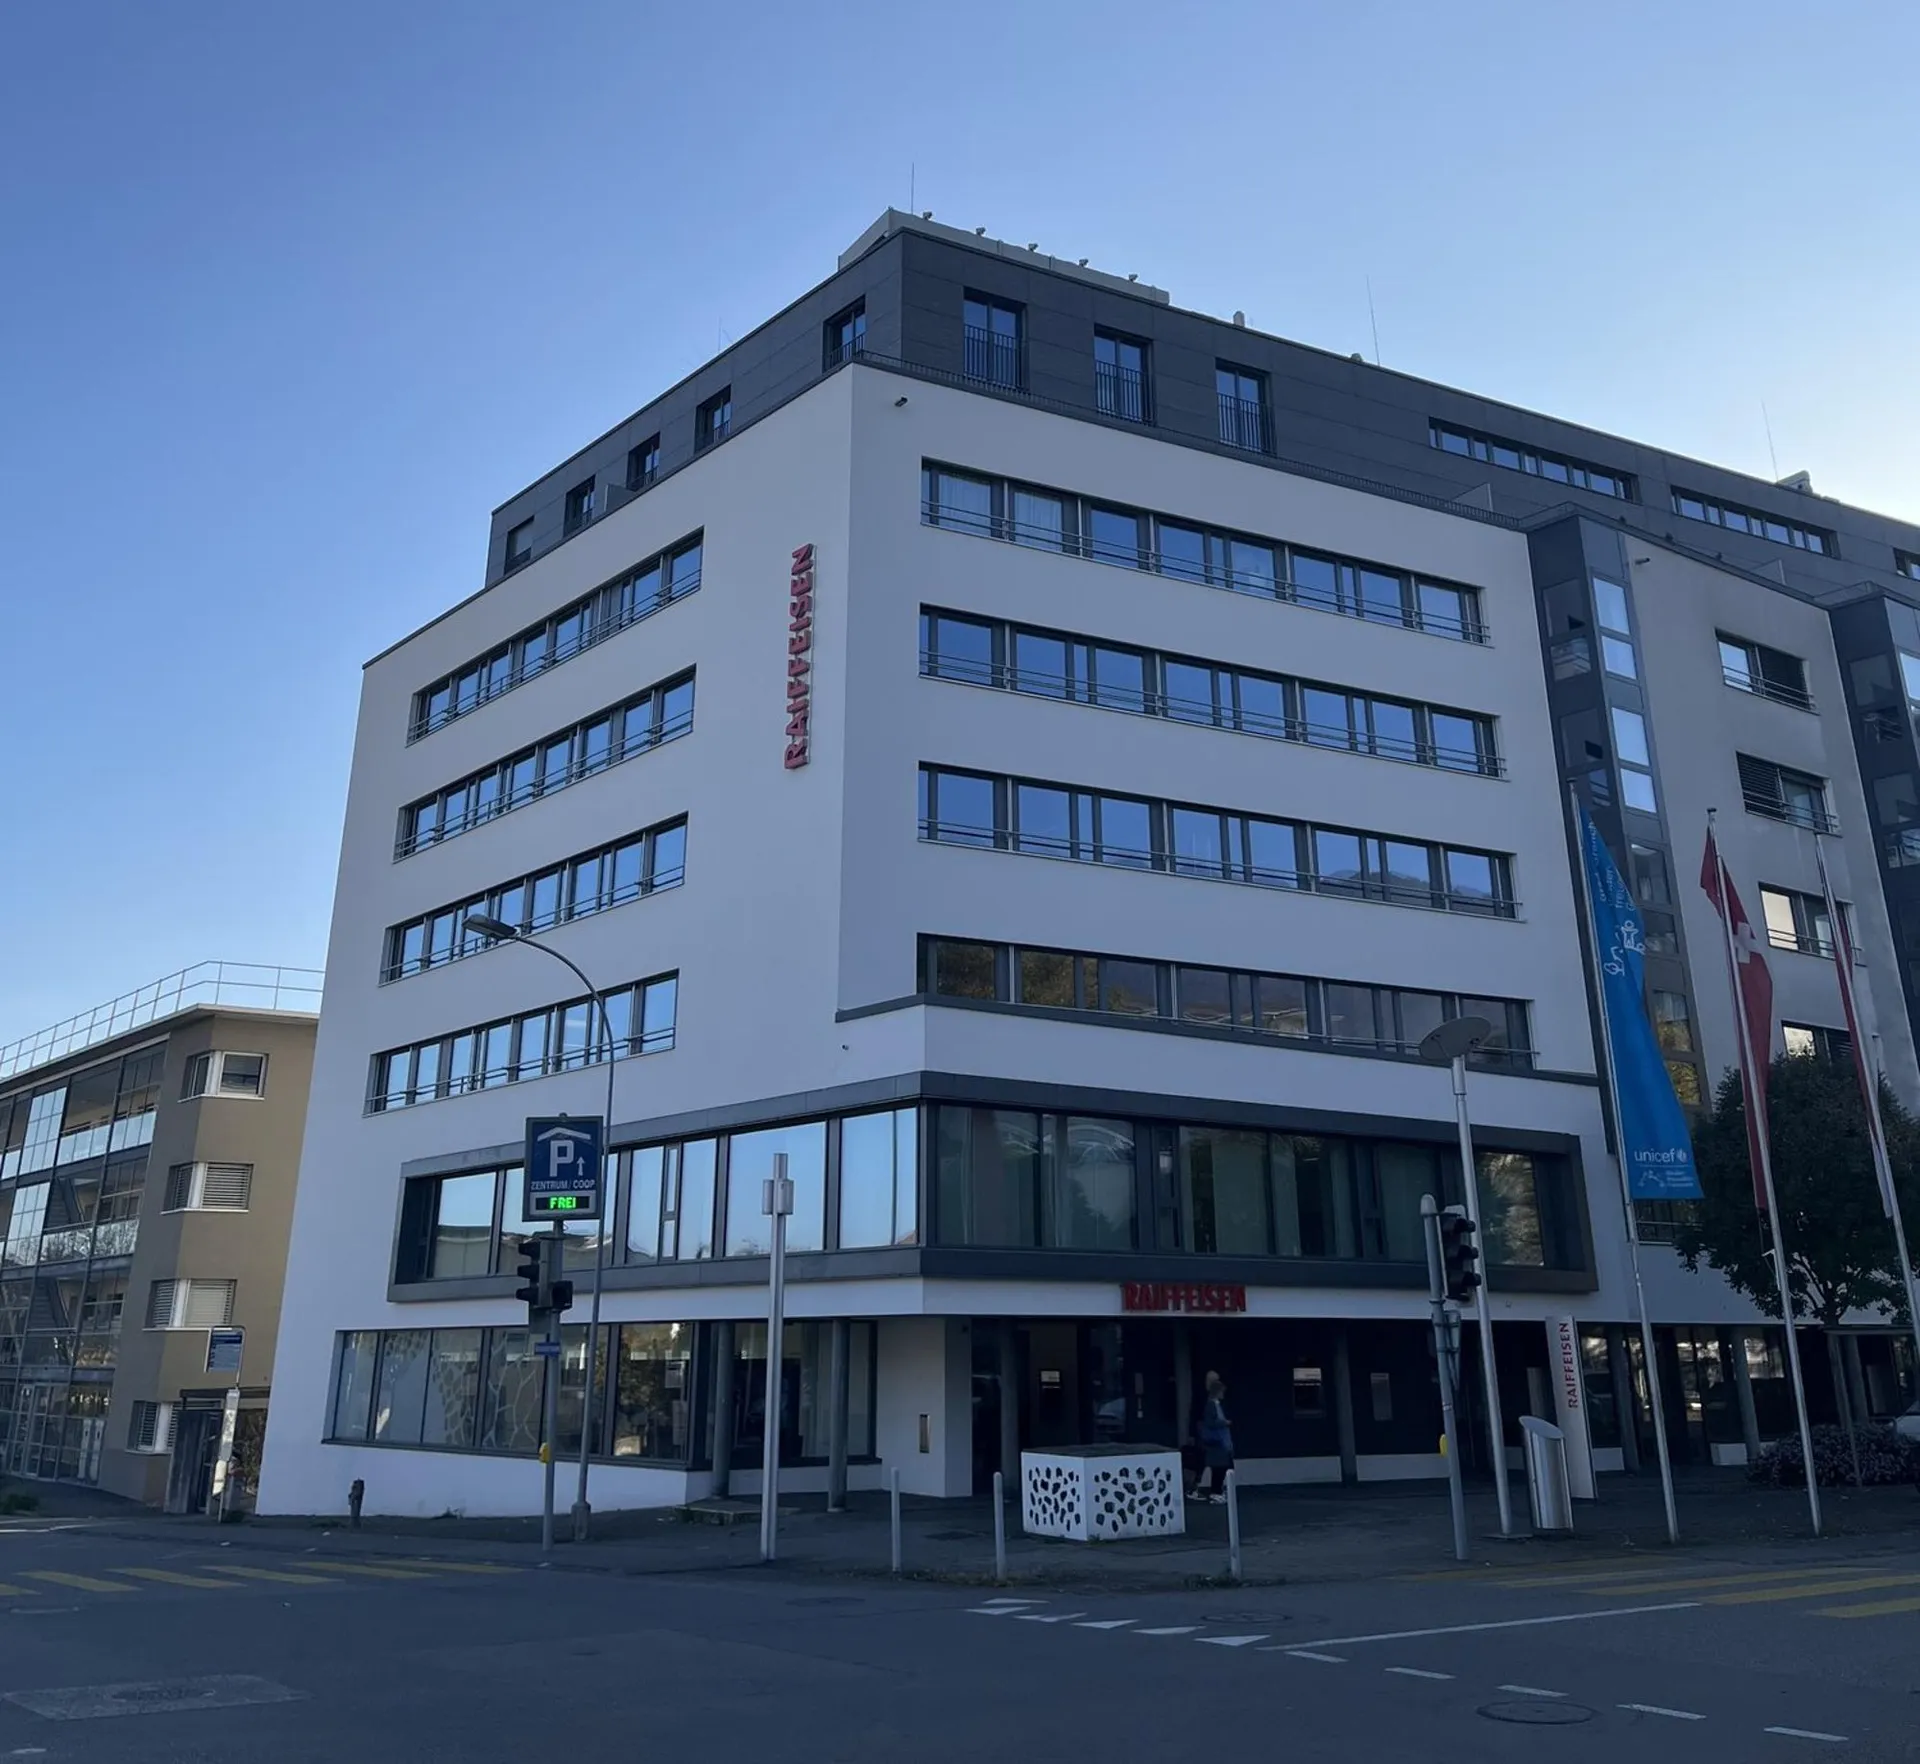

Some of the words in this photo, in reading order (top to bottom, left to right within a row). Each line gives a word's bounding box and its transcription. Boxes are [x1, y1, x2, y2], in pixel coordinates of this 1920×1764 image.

[784, 543, 815, 769] RAIFFEISEN
[549, 1139, 574, 1177] P
[1634, 1148, 1675, 1163] unicef
[572, 1179, 595, 1190] COOP
[549, 1196, 576, 1210] FREI
[1121, 1282, 1246, 1313] RAIFFEISEN
[1559, 1322, 1579, 1409] RAIFFEISEN
